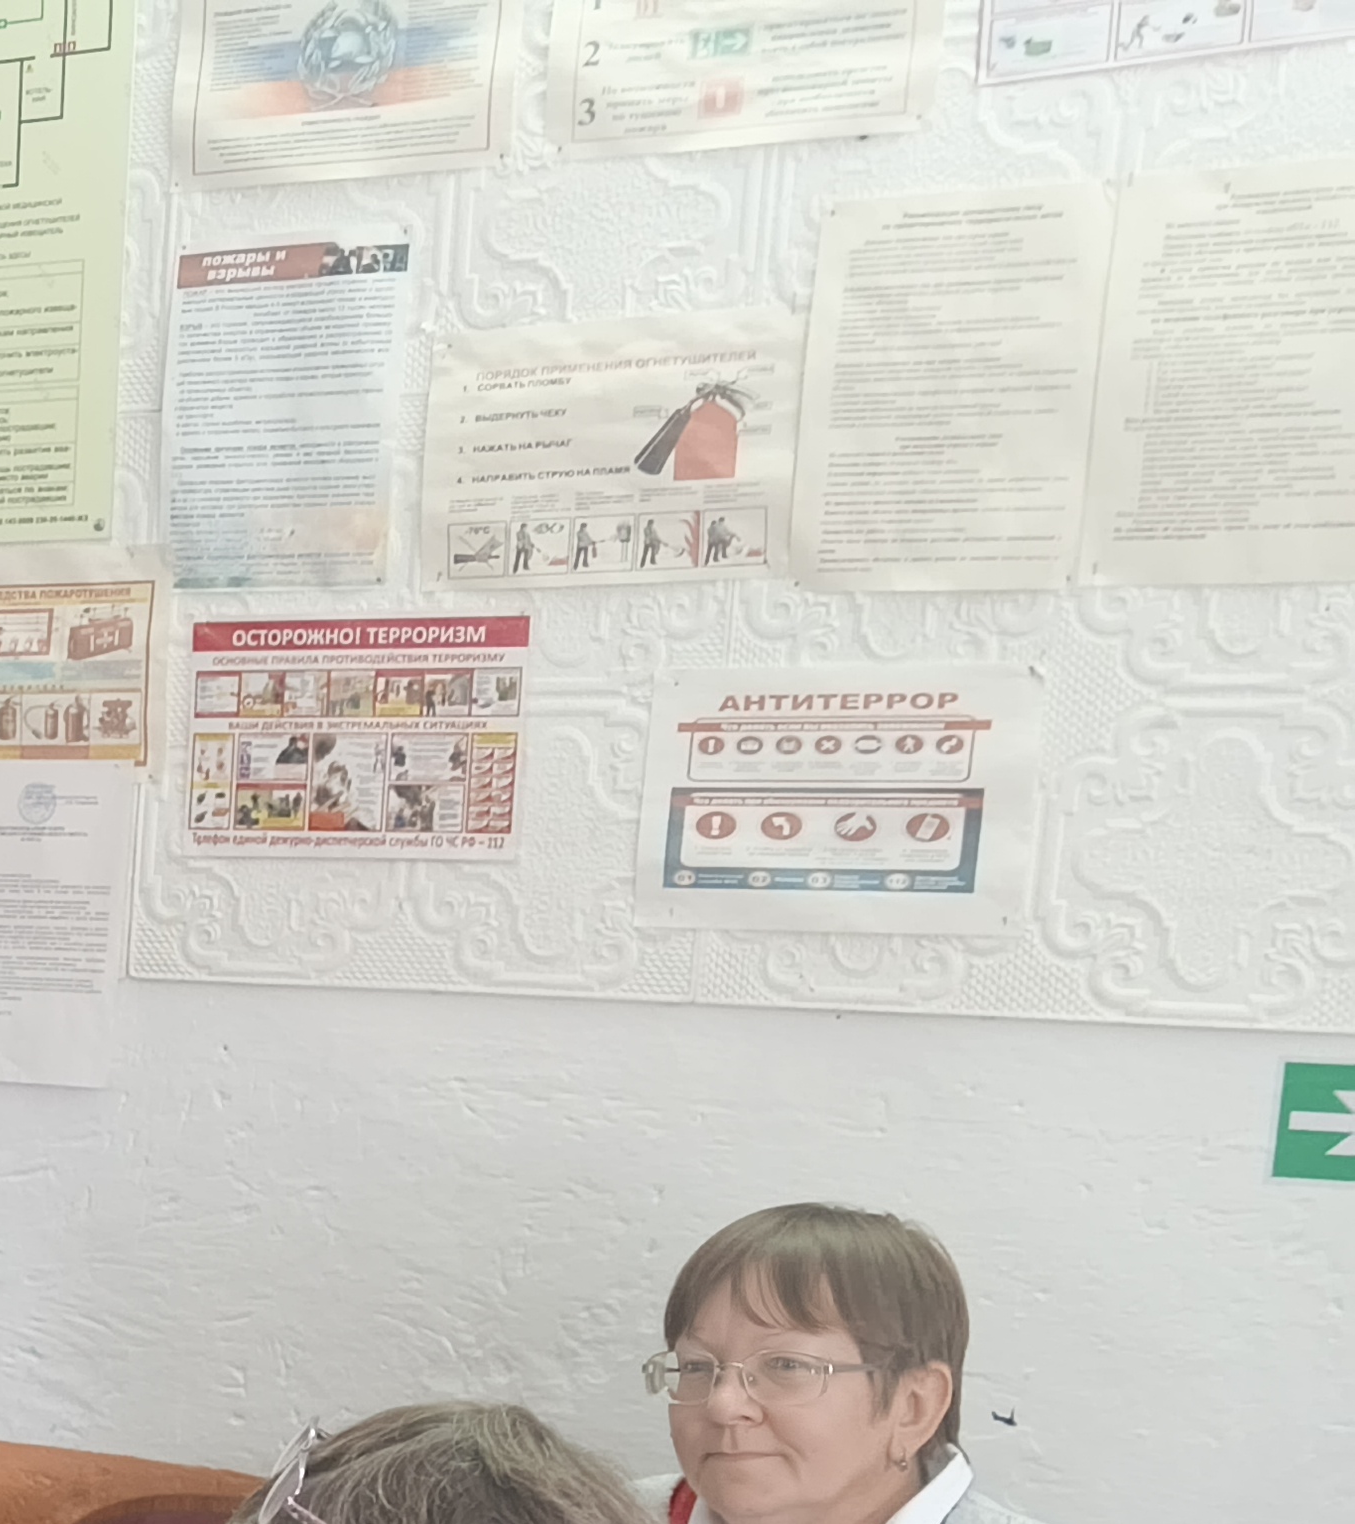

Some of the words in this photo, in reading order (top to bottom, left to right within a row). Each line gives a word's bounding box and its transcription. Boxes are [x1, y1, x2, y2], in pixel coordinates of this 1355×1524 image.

[582, 40, 601, 67] 2
[577, 97, 597, 126] 3
[201, 249, 271, 269] пожары
[274, 249, 287, 262] и
[207, 263, 276, 282] взрывы
[476, 366, 538, 382] ПОРЯДОК
[541, 358, 632, 375] ПРИМЕНЕНИЯ
[636, 349, 757, 370] ОГНЕТУШИТЕЛЕЙ
[477, 381, 525, 393] СОРВАТЬ
[527, 377, 571, 390] ПЛОМБУ
[475, 410, 539, 423] ВЫДЕРНУТЬ
[540, 408, 567, 419] ЧЕКУ
[472, 442, 517, 454] НАЖАТЬ
[518, 441, 533, 451] НА
[471, 471, 536, 484] НАПРАВИТЬ
[537, 469, 575, 481] СТРУЮ
[576, 468, 591, 477] НА
[39, 587, 132, 599] ПОЖАРОТУШЕНИЯ
[232, 626, 361, 647] ОСТОРОЖНО!
[367, 626, 487, 645] ТЕРРОРИЗМ
[212, 655, 268, 666] ОСНОВНЫЕ
[271, 655, 319, 666] ПРАВИЛА
[321, 653, 431, 665] ПРОТИВОДЕЙСТВИЯ
[432, 652, 506, 664] ТЕРРОРИЗМУ
[718, 691, 959, 712] АНТИТЕРРОР
[261, 720, 314, 732] ДЕЙСТВИЯ
[316, 721, 324, 730] В
[423, 720, 488, 732] СИТУАЦИЯХ
[192, 832, 230, 847] Телефон
[232, 832, 268, 846] единой
[389, 835, 428, 850] службы
[430, 836, 444, 848] ГО
[445, 836, 459, 848] ЧС
[460, 836, 477, 849] РФ
